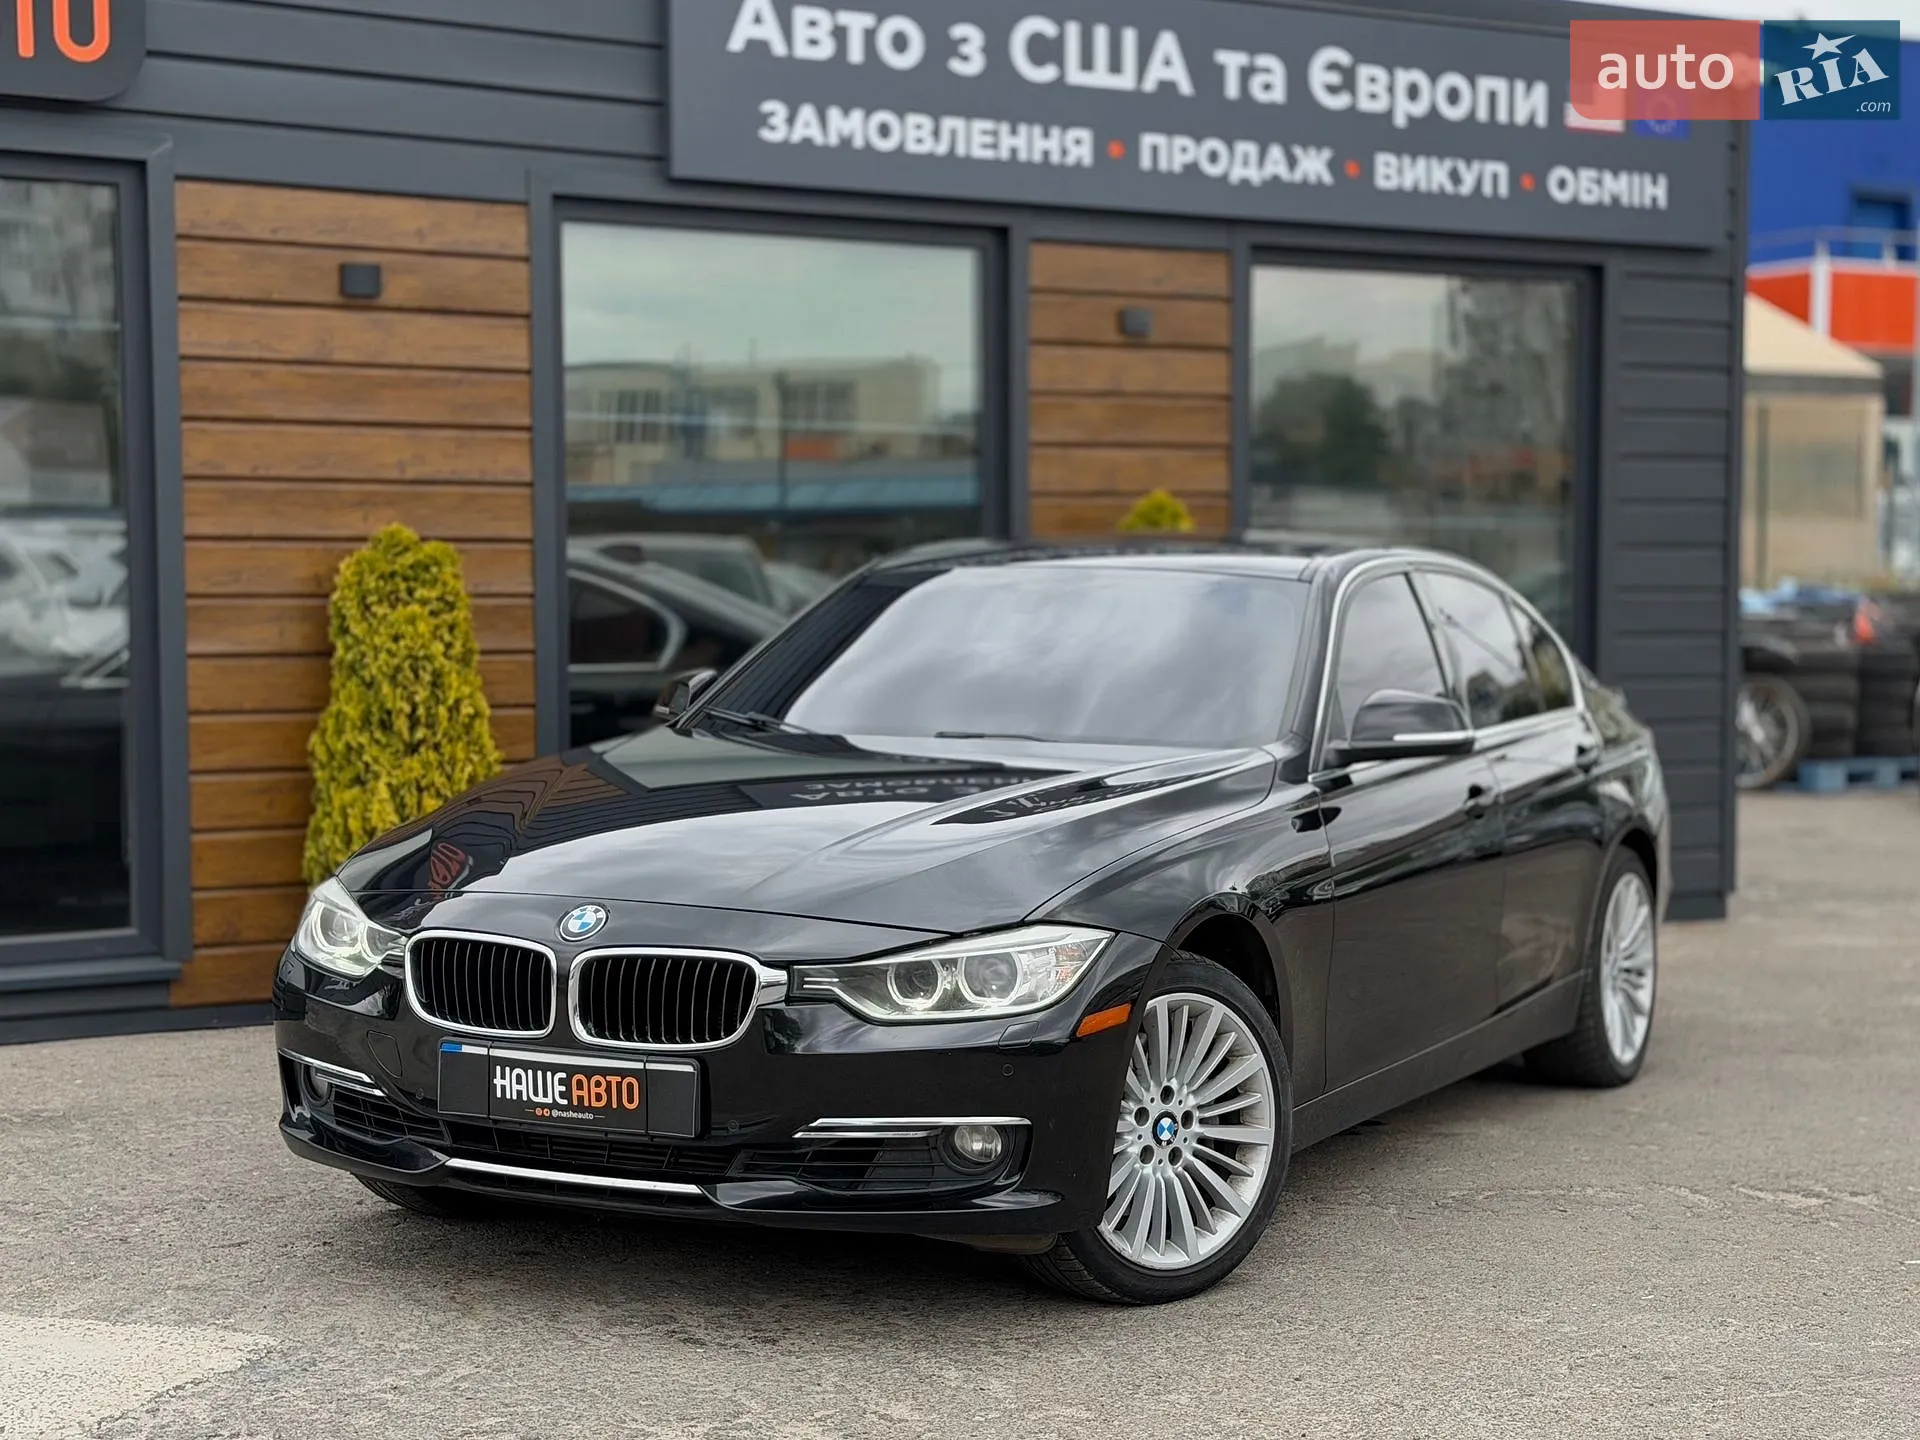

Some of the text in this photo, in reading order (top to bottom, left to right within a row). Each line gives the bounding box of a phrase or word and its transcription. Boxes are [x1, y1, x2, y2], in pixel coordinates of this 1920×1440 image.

[1008, 15, 1196, 97] США
[1213, 48, 1288, 105] та
[1307, 45, 1549, 129] Європи
[757, 99, 1669, 210] ЗАМОВЛЕННЯ ПРОДАЖ ВИКУП ОБМІН
[493, 1065, 640, 1111] НАШЕ АВТО
[551, 1109, 594, 1120] @nasheauto
